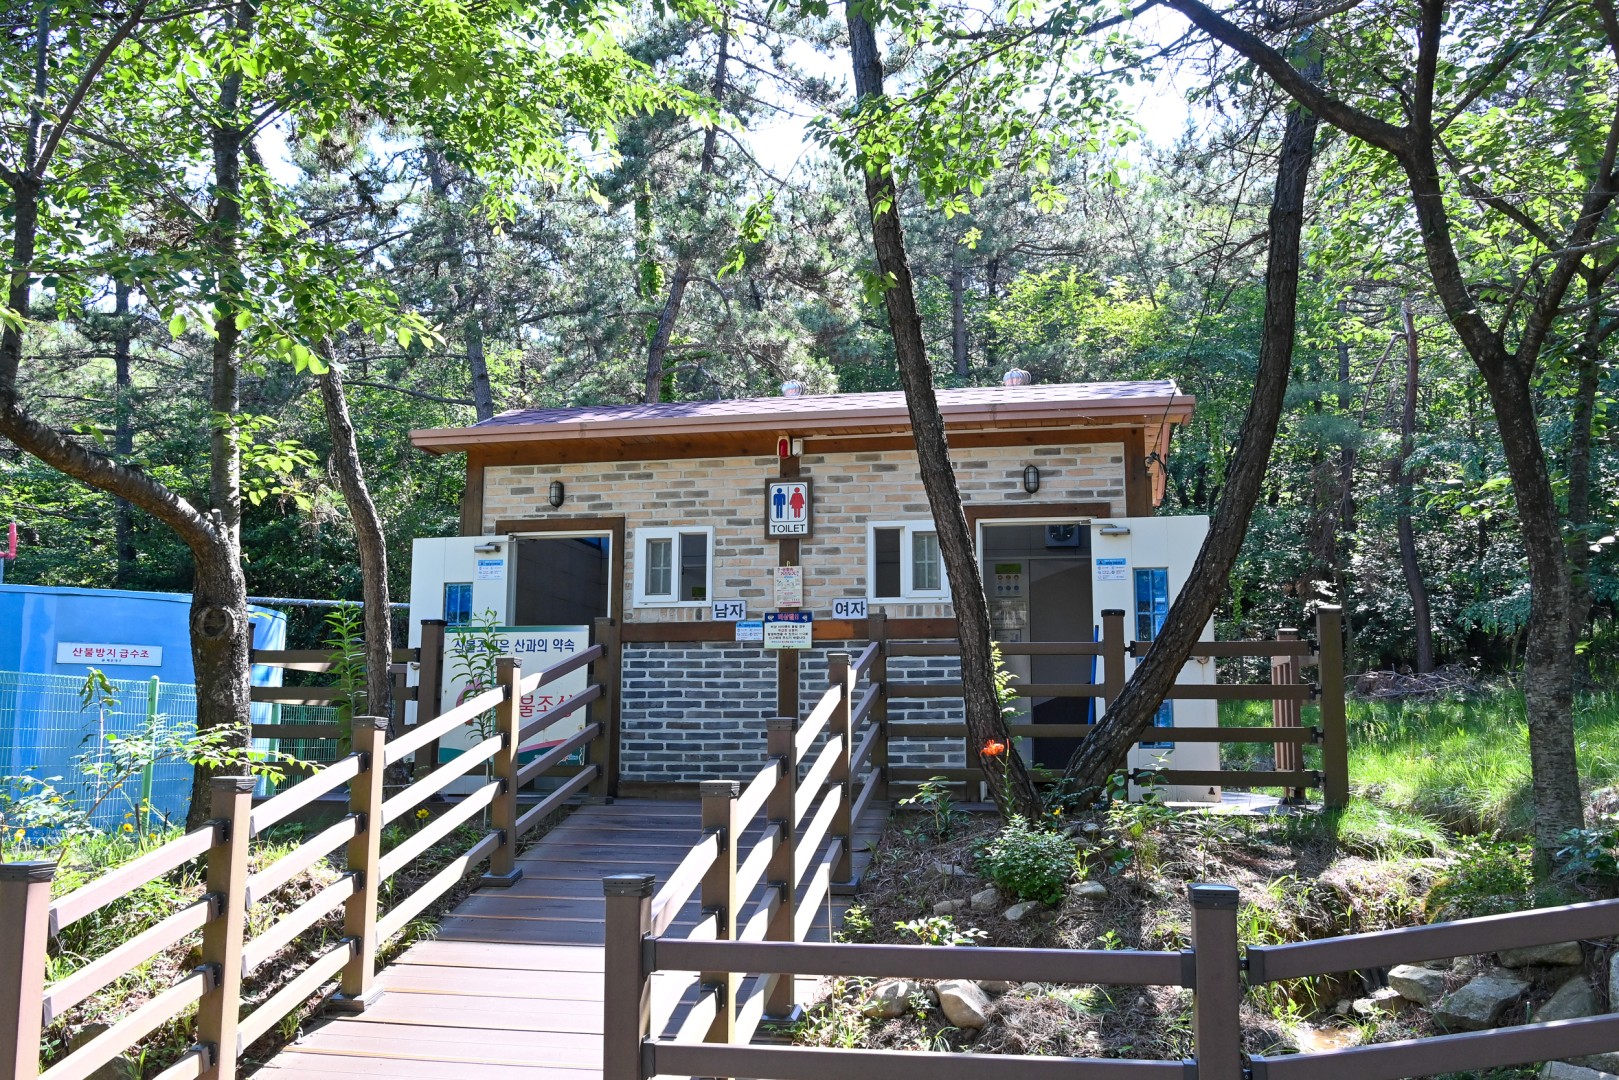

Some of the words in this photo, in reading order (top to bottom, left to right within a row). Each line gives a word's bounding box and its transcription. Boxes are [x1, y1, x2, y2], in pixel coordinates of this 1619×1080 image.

[772, 524, 805, 533] TOILET
[714, 603, 744, 618] 남자
[835, 601, 865, 616] 여자
[72, 647, 116, 658] 산불방지
[119, 648, 150, 659] 급수조
[454, 639, 509, 654] 산불조은
[514, 638, 548, 653] 산과의
[552, 638, 575, 653] 약속
